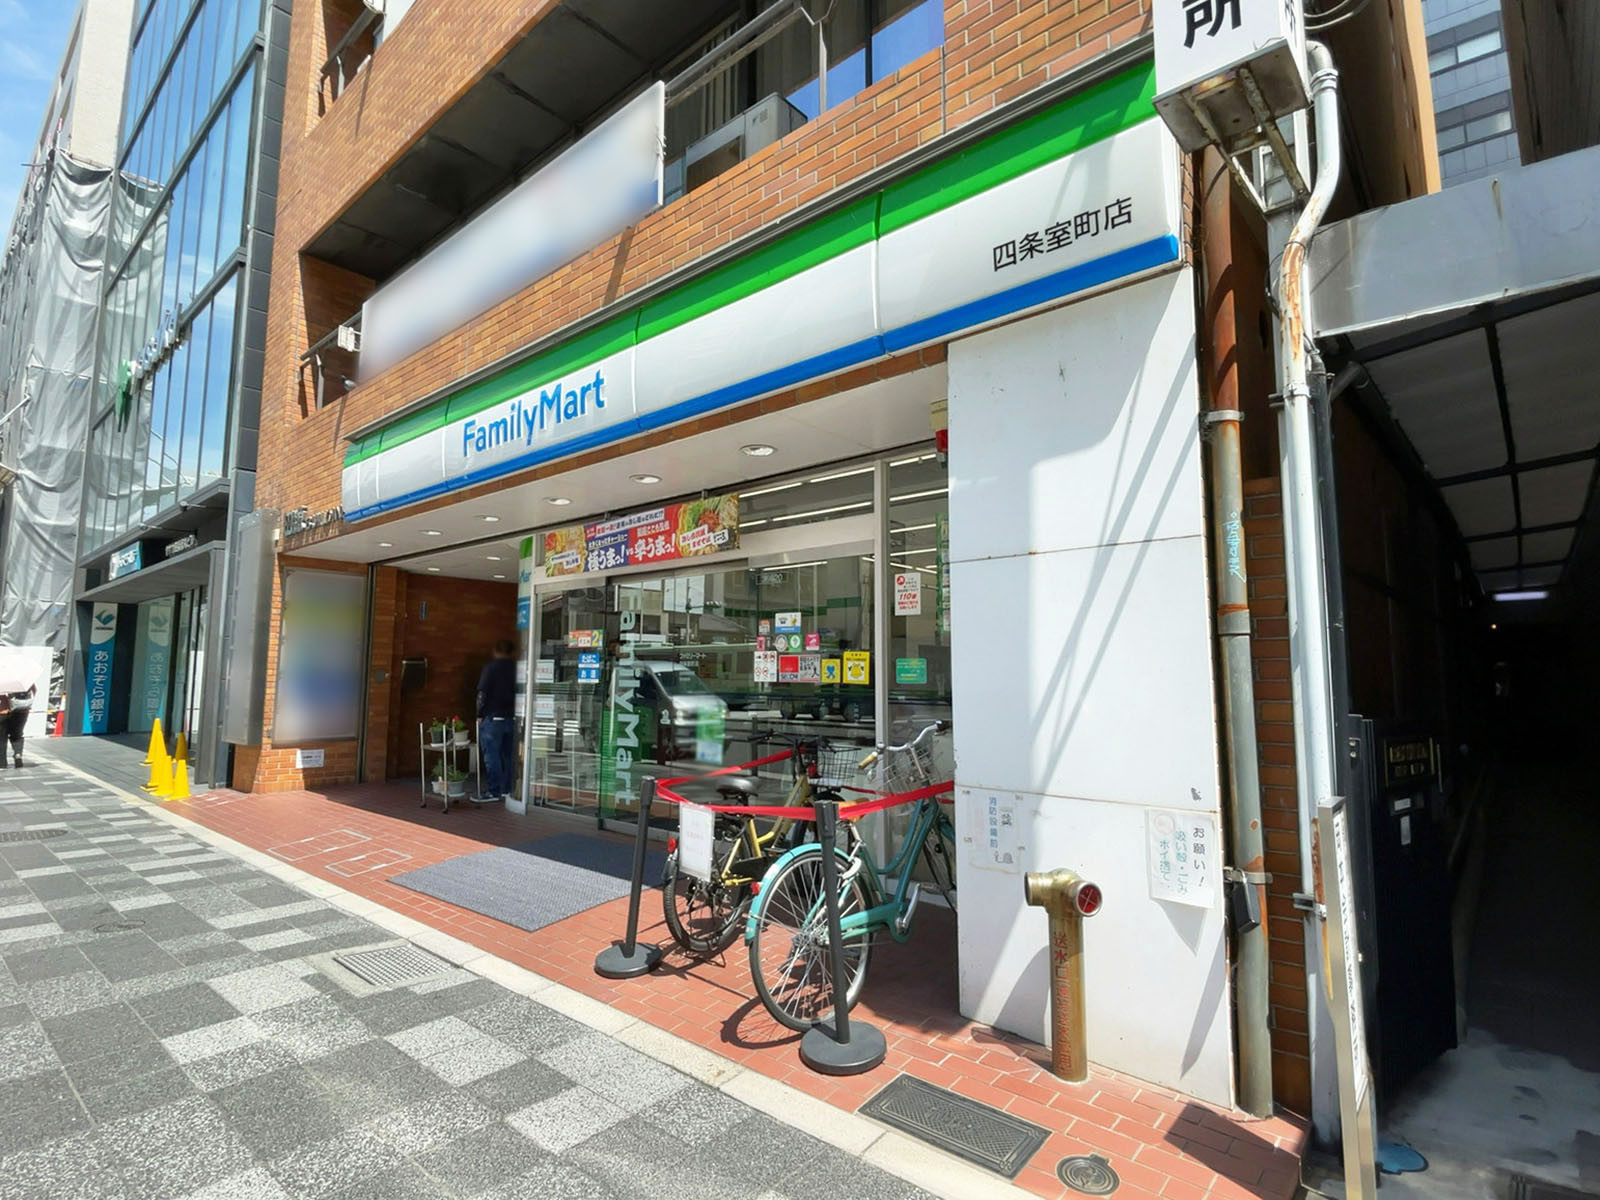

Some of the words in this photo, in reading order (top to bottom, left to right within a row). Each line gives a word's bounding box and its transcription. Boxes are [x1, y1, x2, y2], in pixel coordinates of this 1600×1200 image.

[1182, 0, 1242, 49] 所
[992, 196, 1133, 273] 四条室町店
[463, 369, 605, 457] FamilyMart
[89, 650, 109, 722] あおぞら銀行
[988, 797, 999, 849] 消防設備前
[1193, 827, 1206, 887] お願い!
